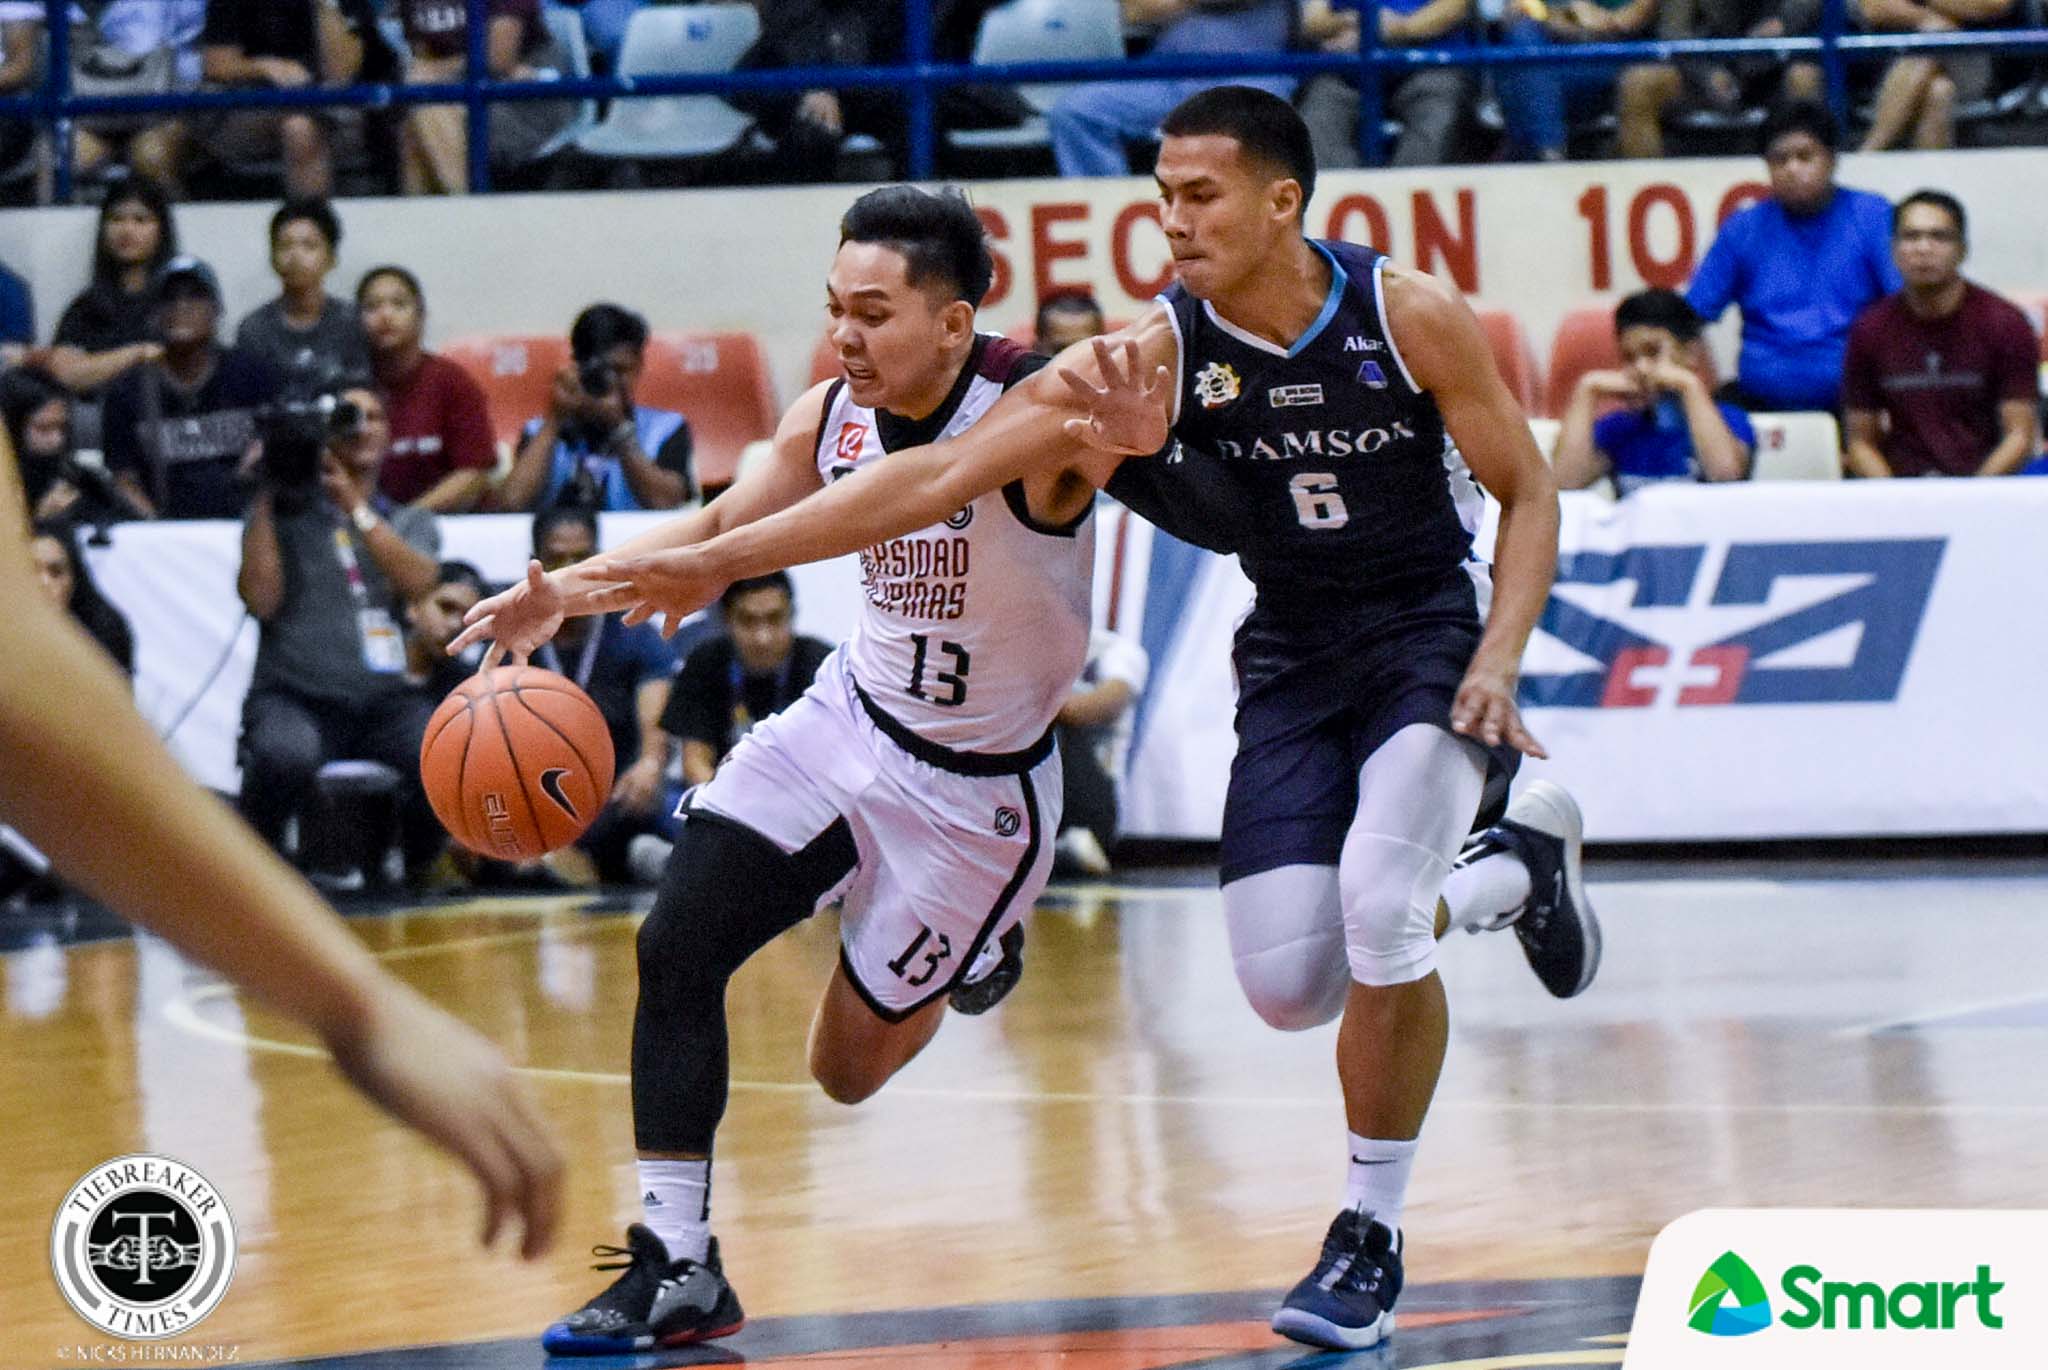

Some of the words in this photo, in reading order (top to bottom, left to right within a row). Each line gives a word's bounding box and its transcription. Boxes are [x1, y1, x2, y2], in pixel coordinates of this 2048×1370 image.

[974, 186, 1479, 310] SECON
[1343, 335, 1388, 353] Akar
[1289, 472, 1349, 530] 6
[861, 537, 970, 578] RSIDAD
[861, 576, 967, 621] LIPINAS
[905, 633, 970, 706] 13
[888, 926, 951, 986] 13
